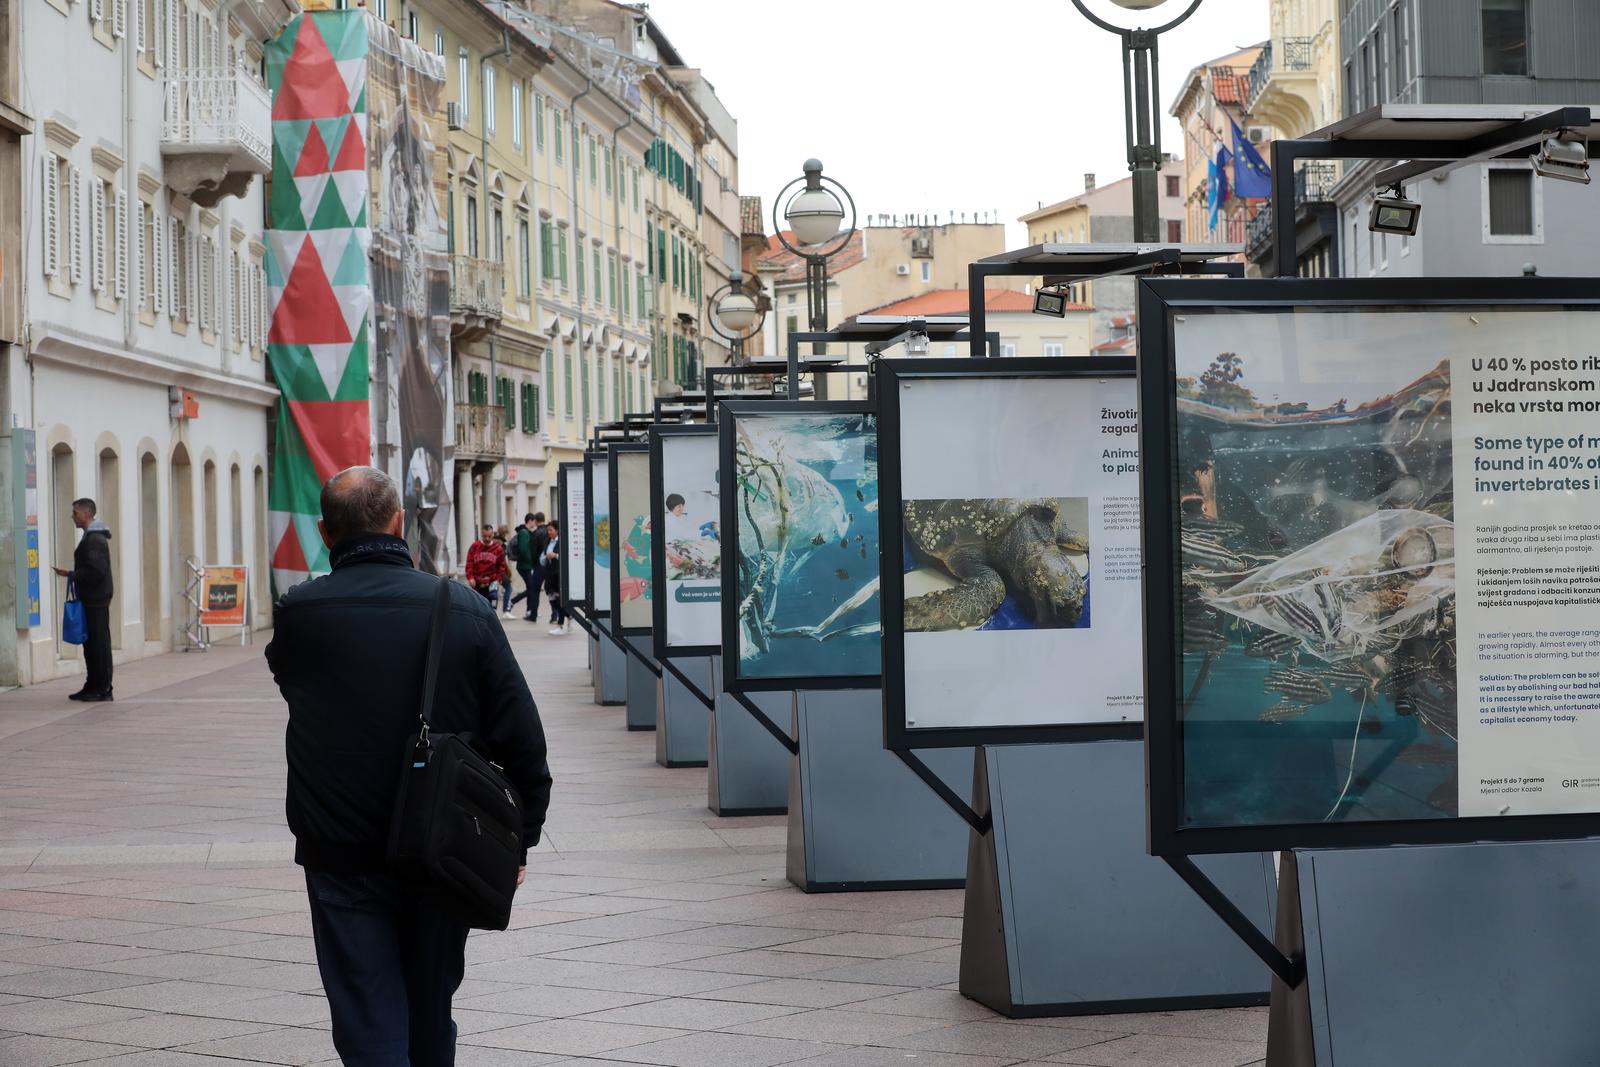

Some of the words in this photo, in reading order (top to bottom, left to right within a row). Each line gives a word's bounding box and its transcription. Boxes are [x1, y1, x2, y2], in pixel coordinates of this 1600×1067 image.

[1472, 358, 1482, 371] U
[1487, 358, 1508, 371] 40
[1512, 358, 1526, 370] %
[1530, 357, 1578, 375] posto
[1472, 381, 1482, 392] u
[1487, 378, 1594, 392] Jadranskom
[1474, 399, 1515, 413] neka
[1520, 400, 1564, 412] vrsta
[1474, 436, 1522, 450] Some
[1526, 436, 1564, 453] type
[1568, 434, 1584, 448] of
[1474, 456, 1524, 470] found
[1528, 456, 1543, 470] in
[1548, 456, 1583, 470] 40%
[1102, 464, 1114, 472] to
[1475, 476, 1590, 492] invertebrates
[1477, 525, 1500, 534] Ranijih
[1503, 525, 1528, 534] godina
[1531, 524, 1556, 533] prosjek
[1500, 536, 1522, 544] druga
[1534, 545, 1563, 554] rješenja
[1565, 545, 1594, 553] postoje.
[1477, 568, 1510, 576] Rješenje:
[1576, 565, 1599, 574] riješiti
[1513, 598, 1553, 607] nuspojava
[1479, 642, 1509, 651] growing
[1510, 642, 1537, 650] rapidly.
[1529, 672, 1560, 681] problem
[1507, 684, 1516, 693] by
[1518, 683, 1558, 691] abolishing
[1497, 706, 1526, 714] lifestyle
[1480, 717, 1515, 725] capitalist
[1562, 780, 1579, 788] GIR
